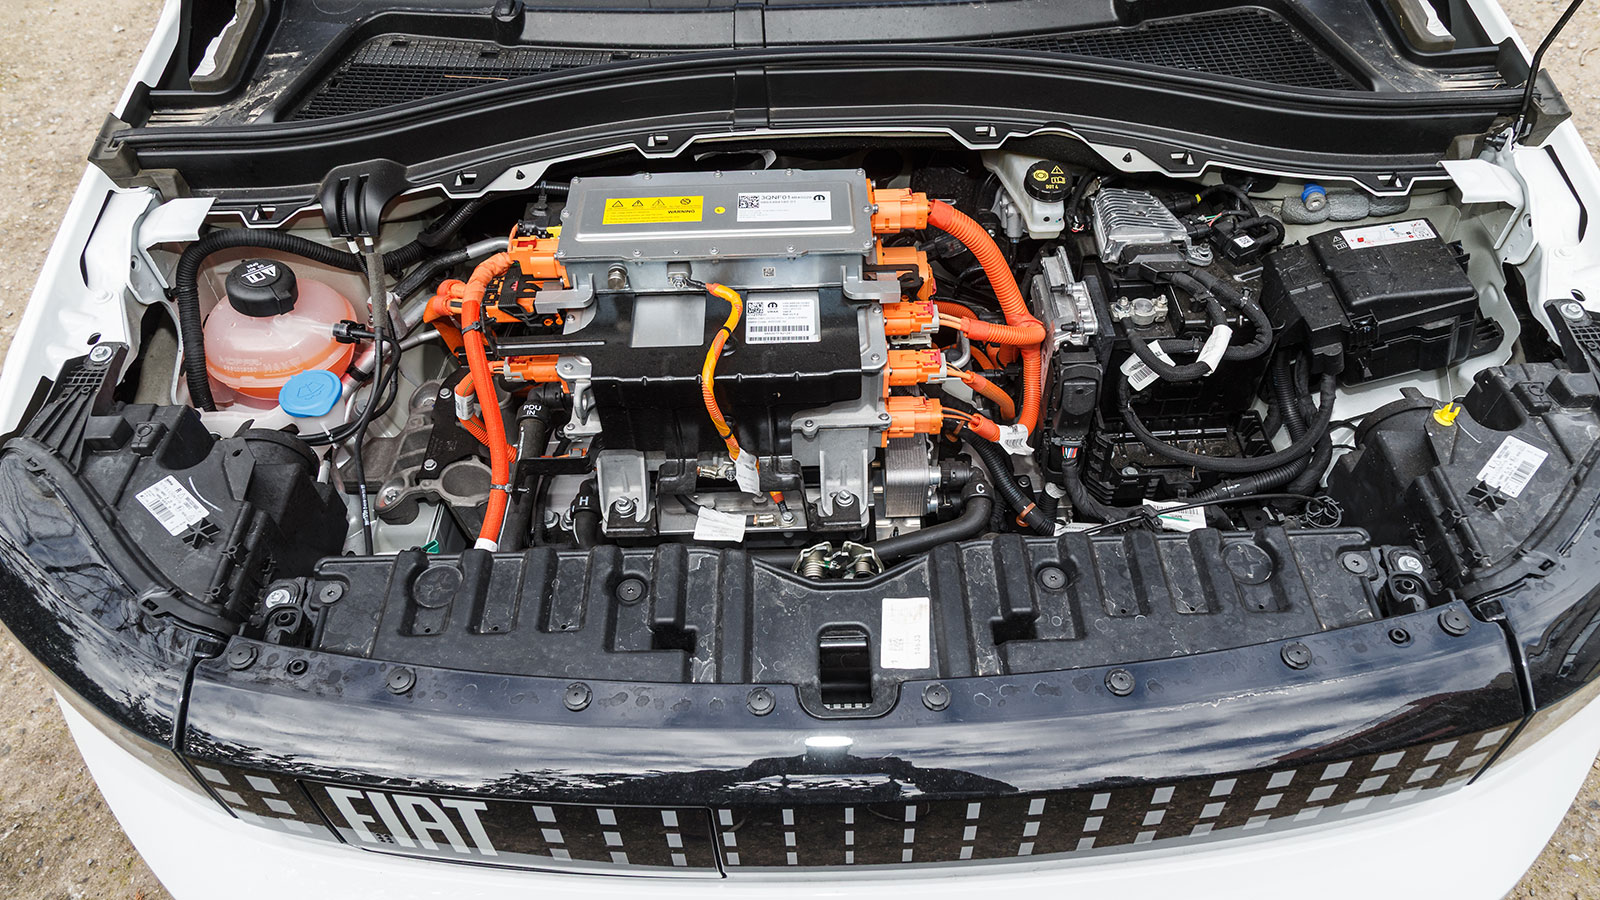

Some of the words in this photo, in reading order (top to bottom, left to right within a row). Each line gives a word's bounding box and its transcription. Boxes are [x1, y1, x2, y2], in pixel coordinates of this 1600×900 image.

[976, 483, 985, 494] C
[579, 496, 589, 506] H
[325, 786, 498, 856] FIAT
